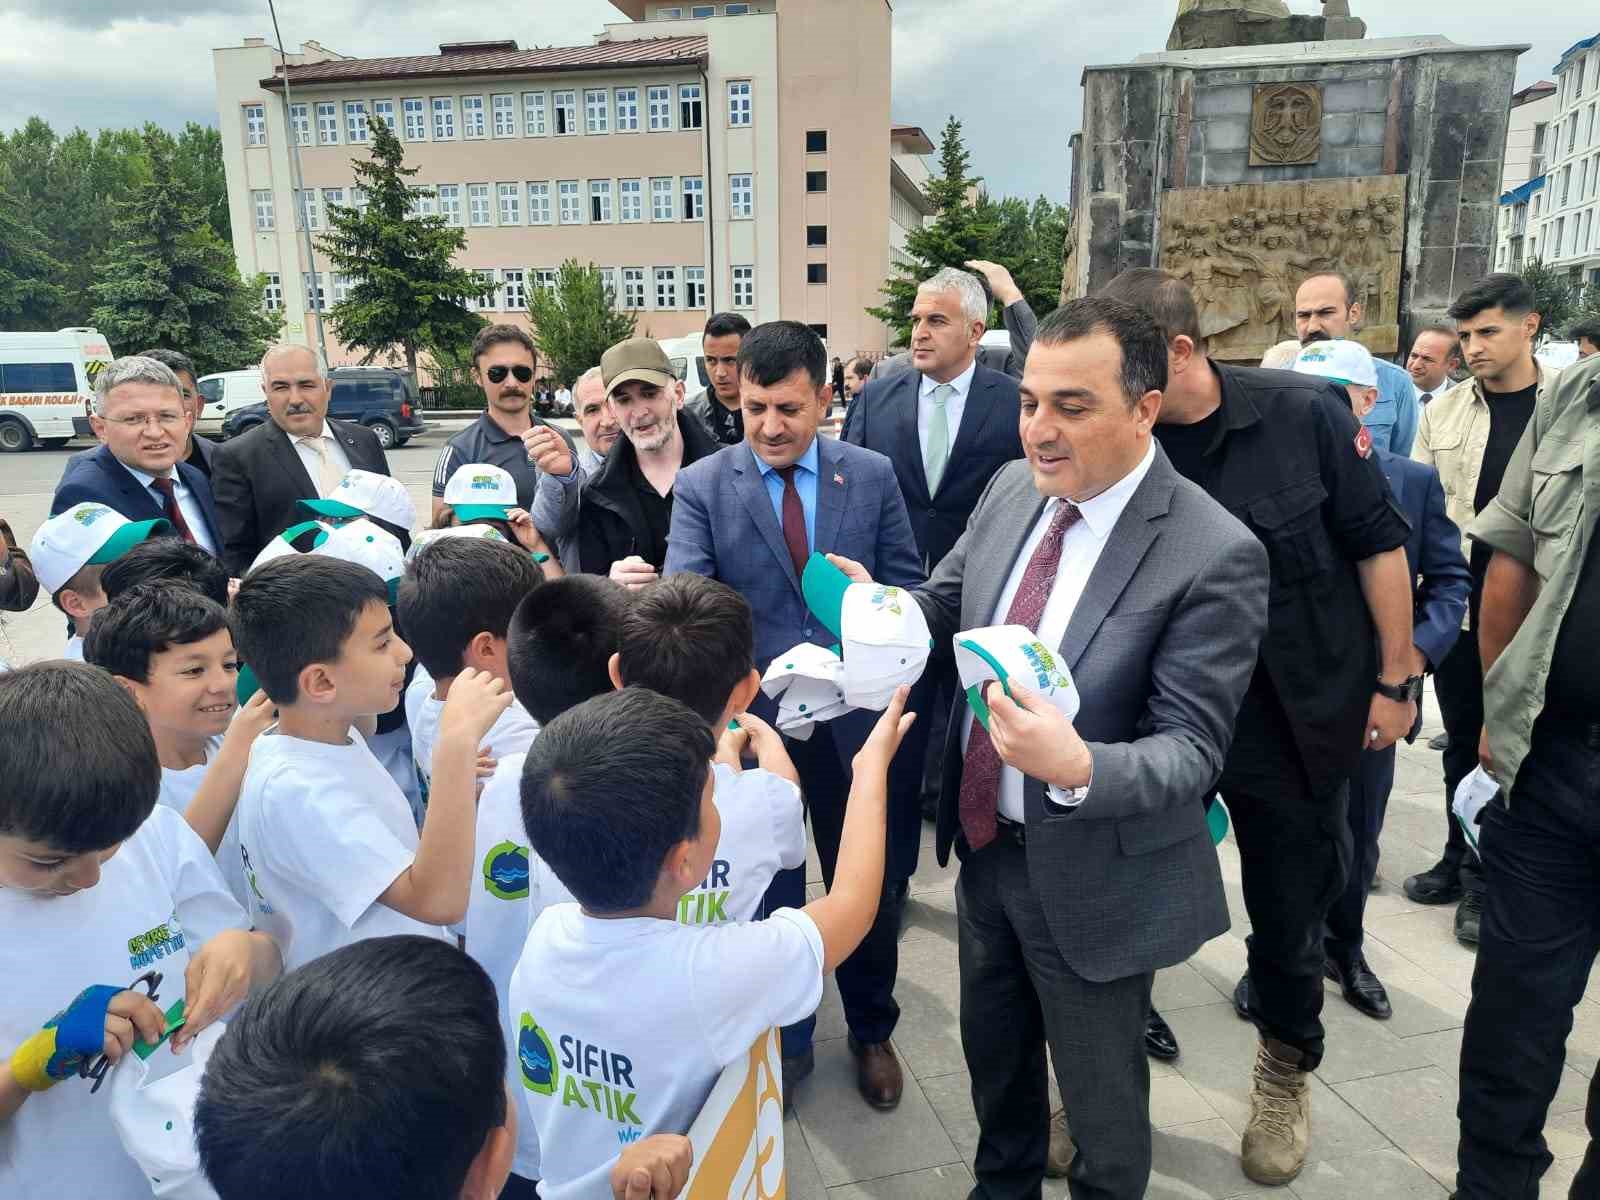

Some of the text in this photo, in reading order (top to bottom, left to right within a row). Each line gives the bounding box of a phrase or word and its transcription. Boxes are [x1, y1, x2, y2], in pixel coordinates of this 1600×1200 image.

[680, 890, 729, 924] TIK
[559, 1034, 635, 1089] SIFIR
[562, 1074, 643, 1125] ATIK
